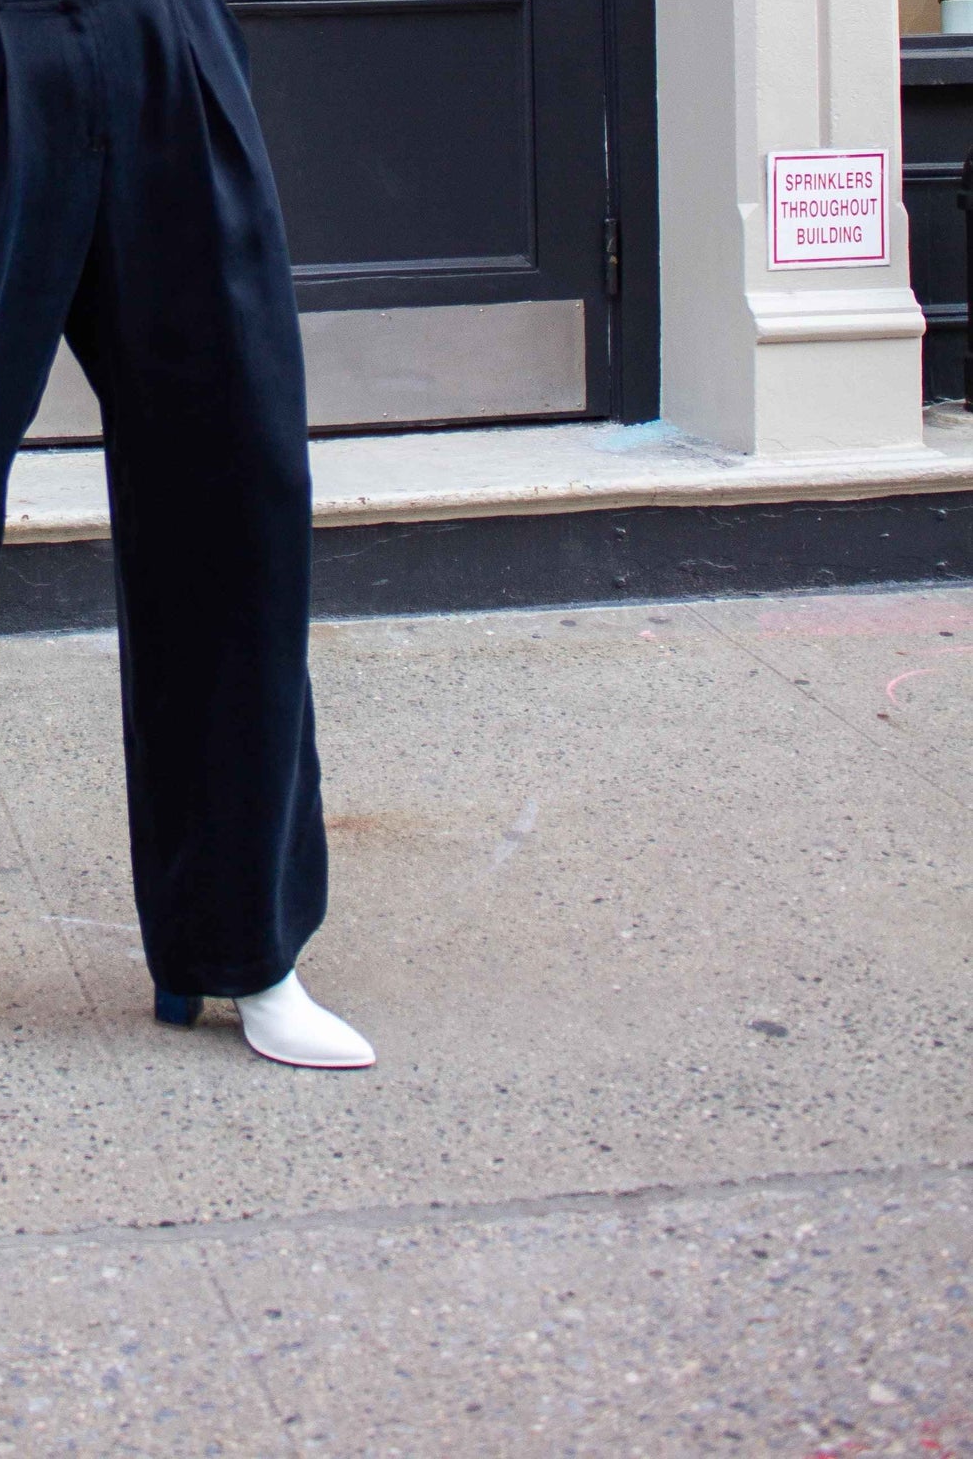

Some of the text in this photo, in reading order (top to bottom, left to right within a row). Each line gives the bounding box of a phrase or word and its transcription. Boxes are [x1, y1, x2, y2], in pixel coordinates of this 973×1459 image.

[785, 171, 873, 191] SPRINKLERS
[781, 198, 878, 219] THROUGHOUT
[797, 225, 862, 245] BUILDING
